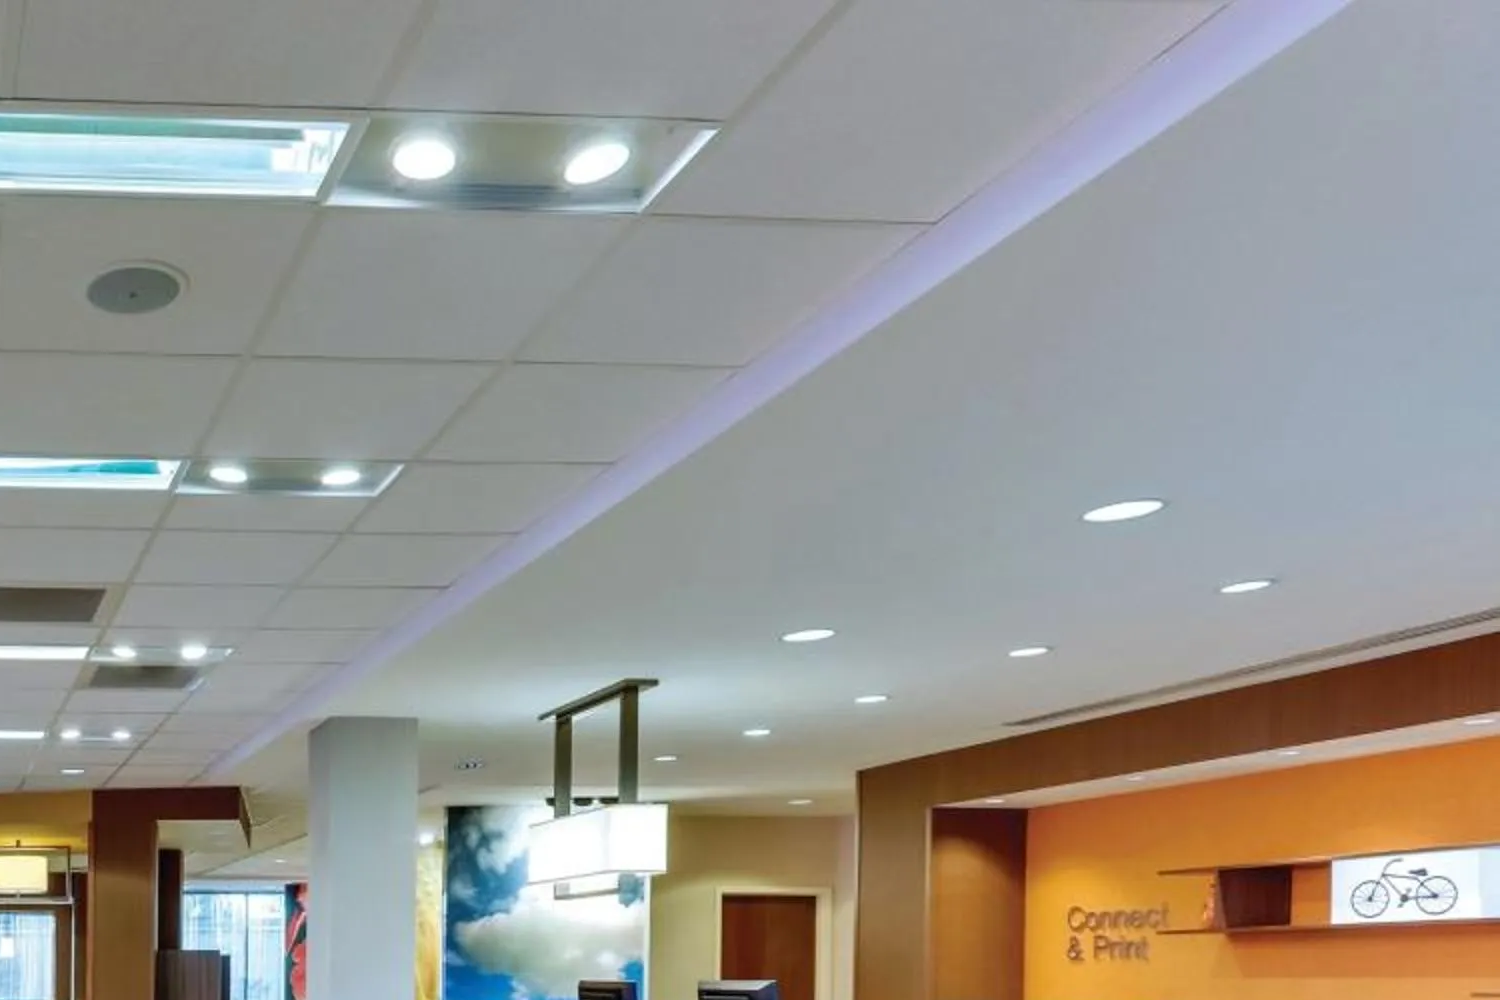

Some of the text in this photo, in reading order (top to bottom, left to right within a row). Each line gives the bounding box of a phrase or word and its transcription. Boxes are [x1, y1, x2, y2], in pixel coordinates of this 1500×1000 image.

[1067, 902, 1169, 932] Connect
[1067, 936, 1149, 962] & Print
